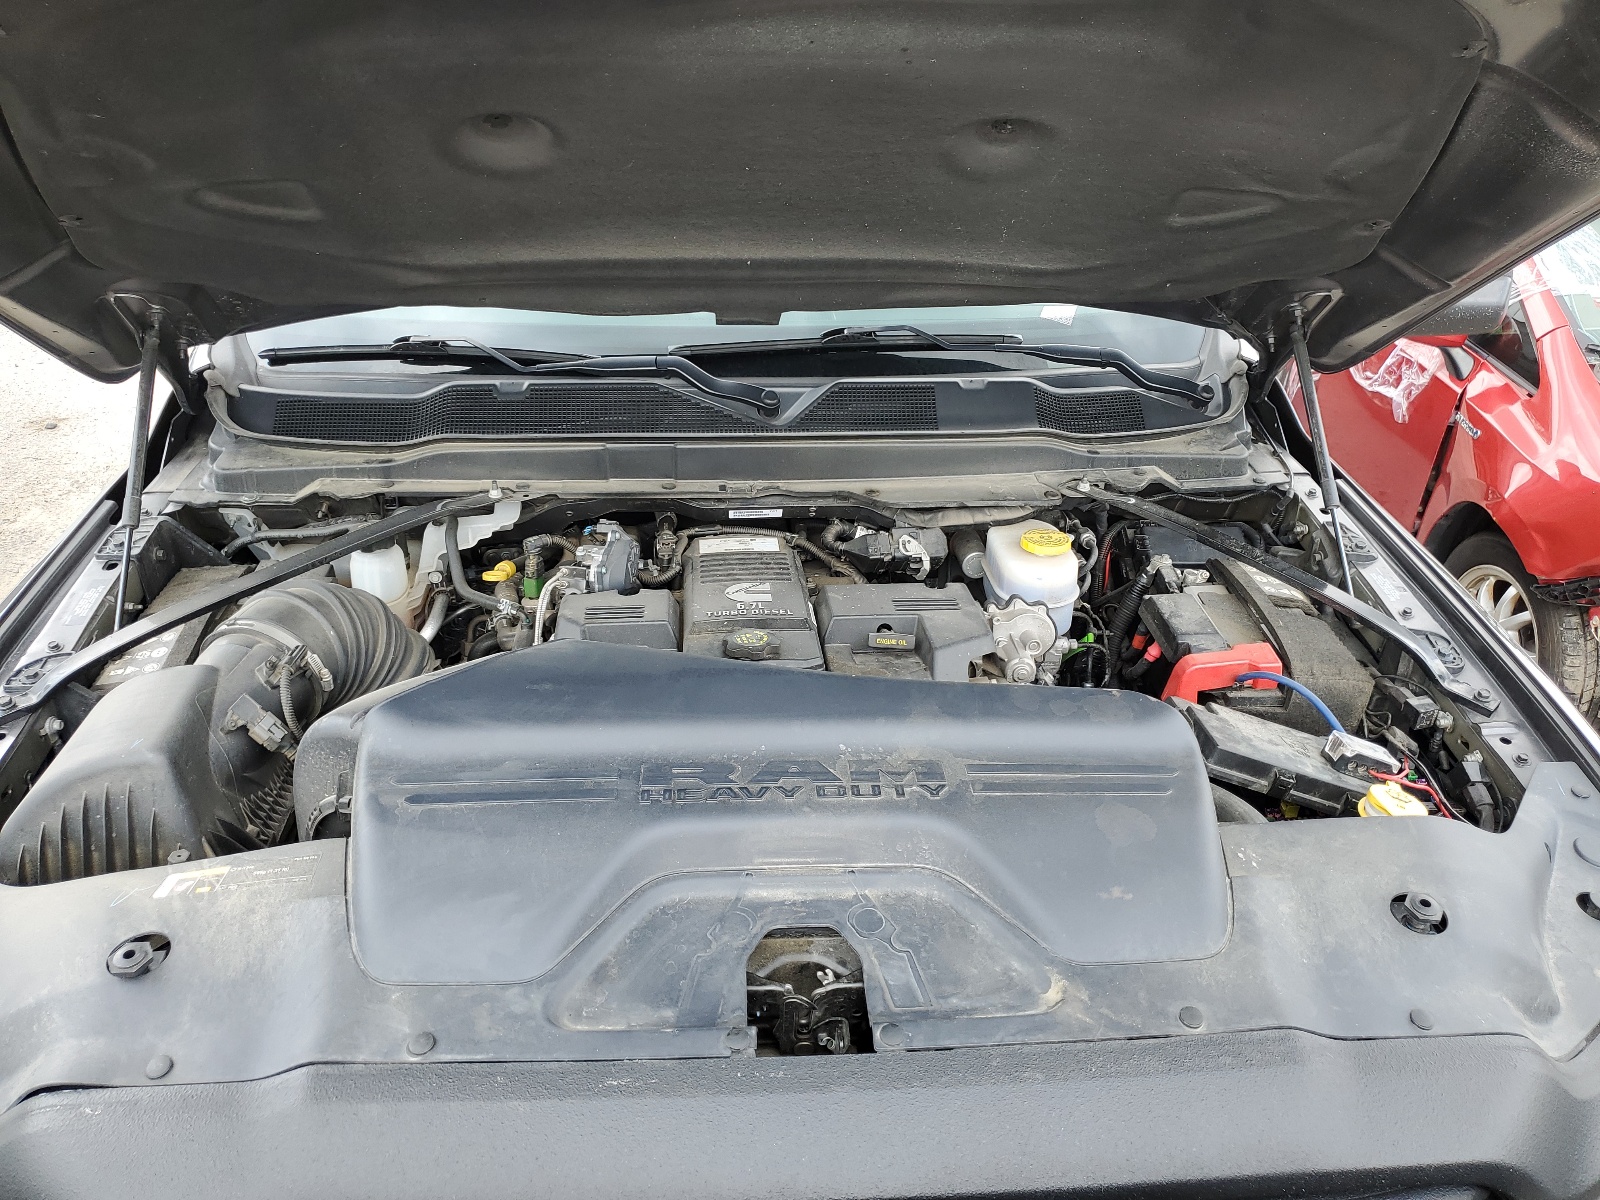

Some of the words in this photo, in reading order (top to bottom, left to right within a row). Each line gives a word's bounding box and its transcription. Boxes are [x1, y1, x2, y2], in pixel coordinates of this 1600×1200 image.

[706, 609, 747, 617] TURBO
[736, 602, 765, 610] 6.7L
[640, 760, 947, 786] RAM
[639, 785, 805, 804] HEAVY
[815, 784, 948, 799] DUTY
